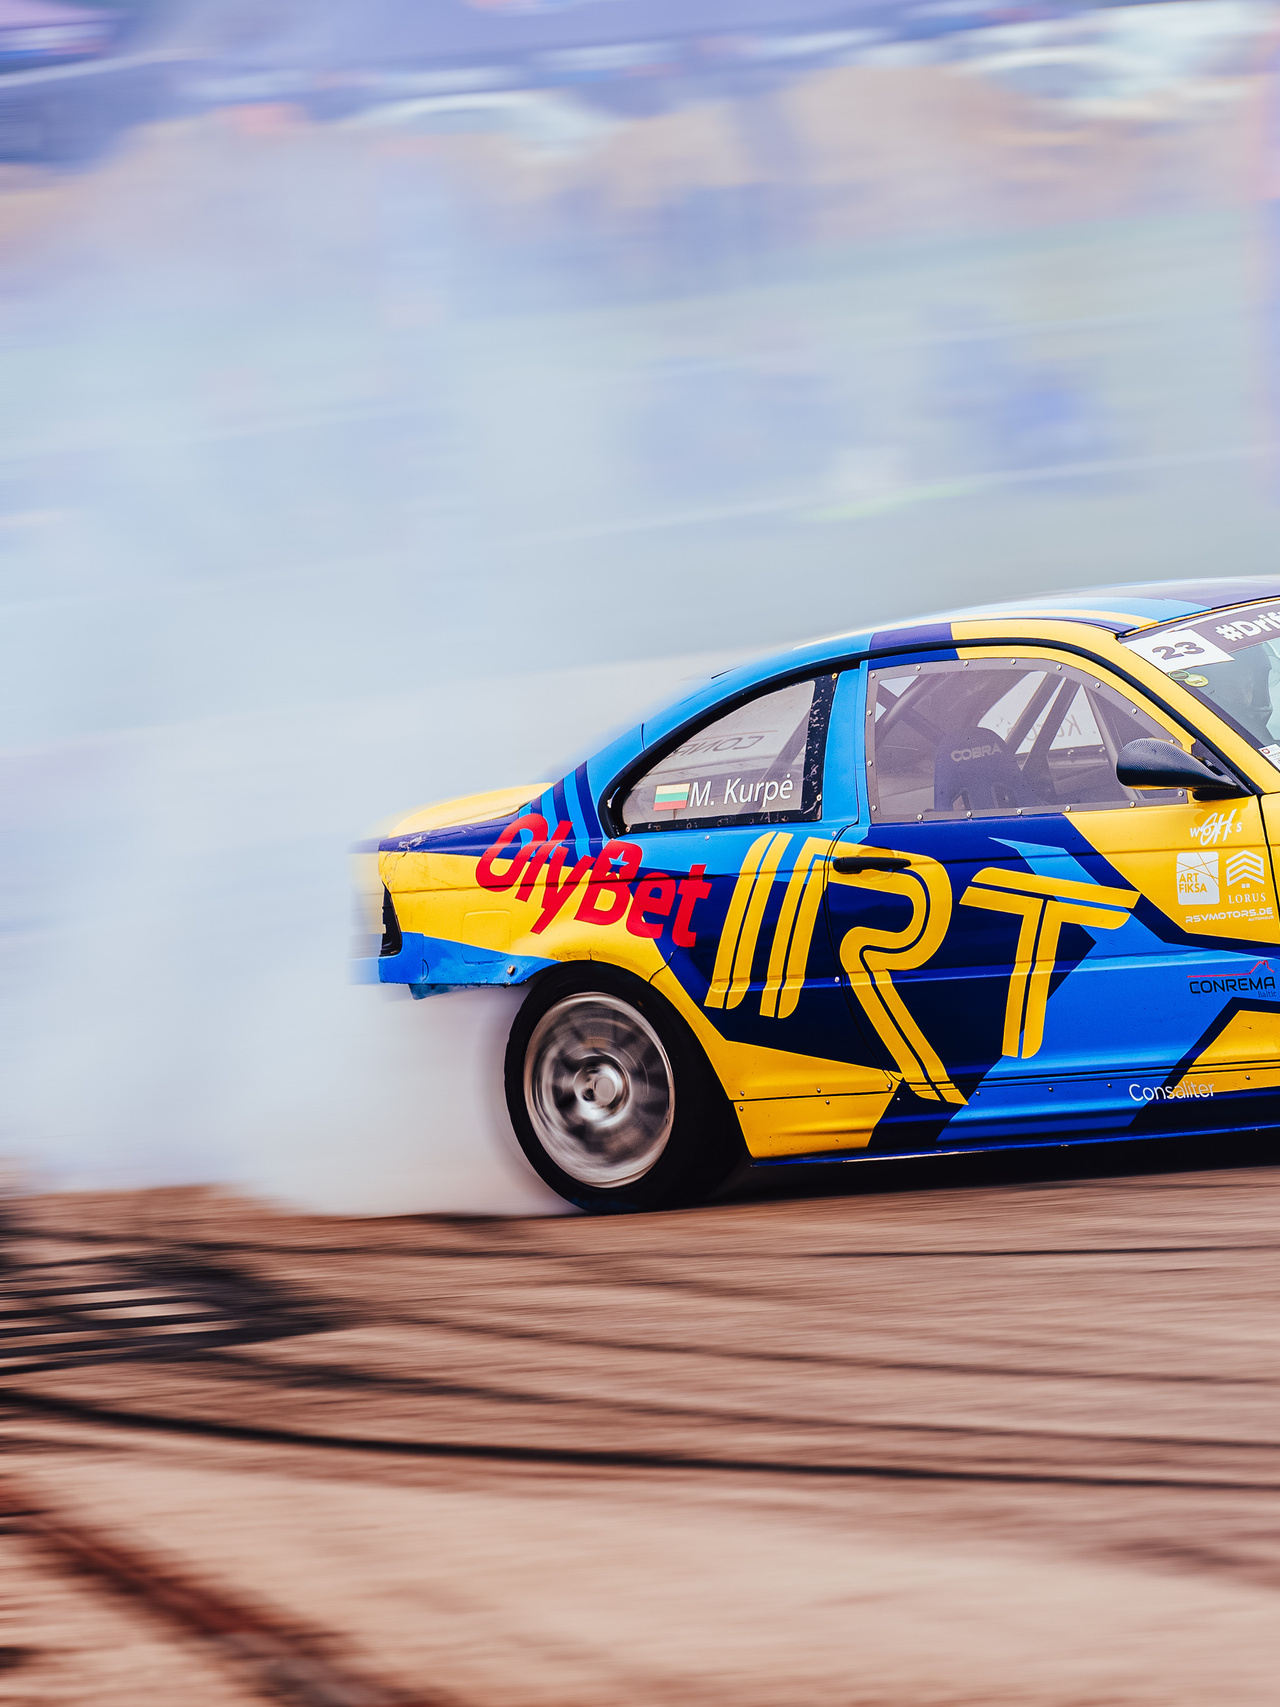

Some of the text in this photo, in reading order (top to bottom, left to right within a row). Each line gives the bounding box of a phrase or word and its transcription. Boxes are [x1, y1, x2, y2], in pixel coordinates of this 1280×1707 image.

[1151, 641, 1205, 661] 23
[950, 743, 1003, 763] COBRA
[689, 773, 793, 808] M. Kurpė
[475, 812, 713, 948] OlyBet
[1179, 872, 1199, 883] ART
[1179, 882, 1208, 894] FIKSA
[1228, 892, 1267, 904] LORUS
[1185, 906, 1274, 924] RSVMOTORS.DE
[1189, 976, 1276, 994] CONREMA
[1258, 990, 1278, 999] Baltic
[1128, 1080, 1215, 1102] Consaliter
